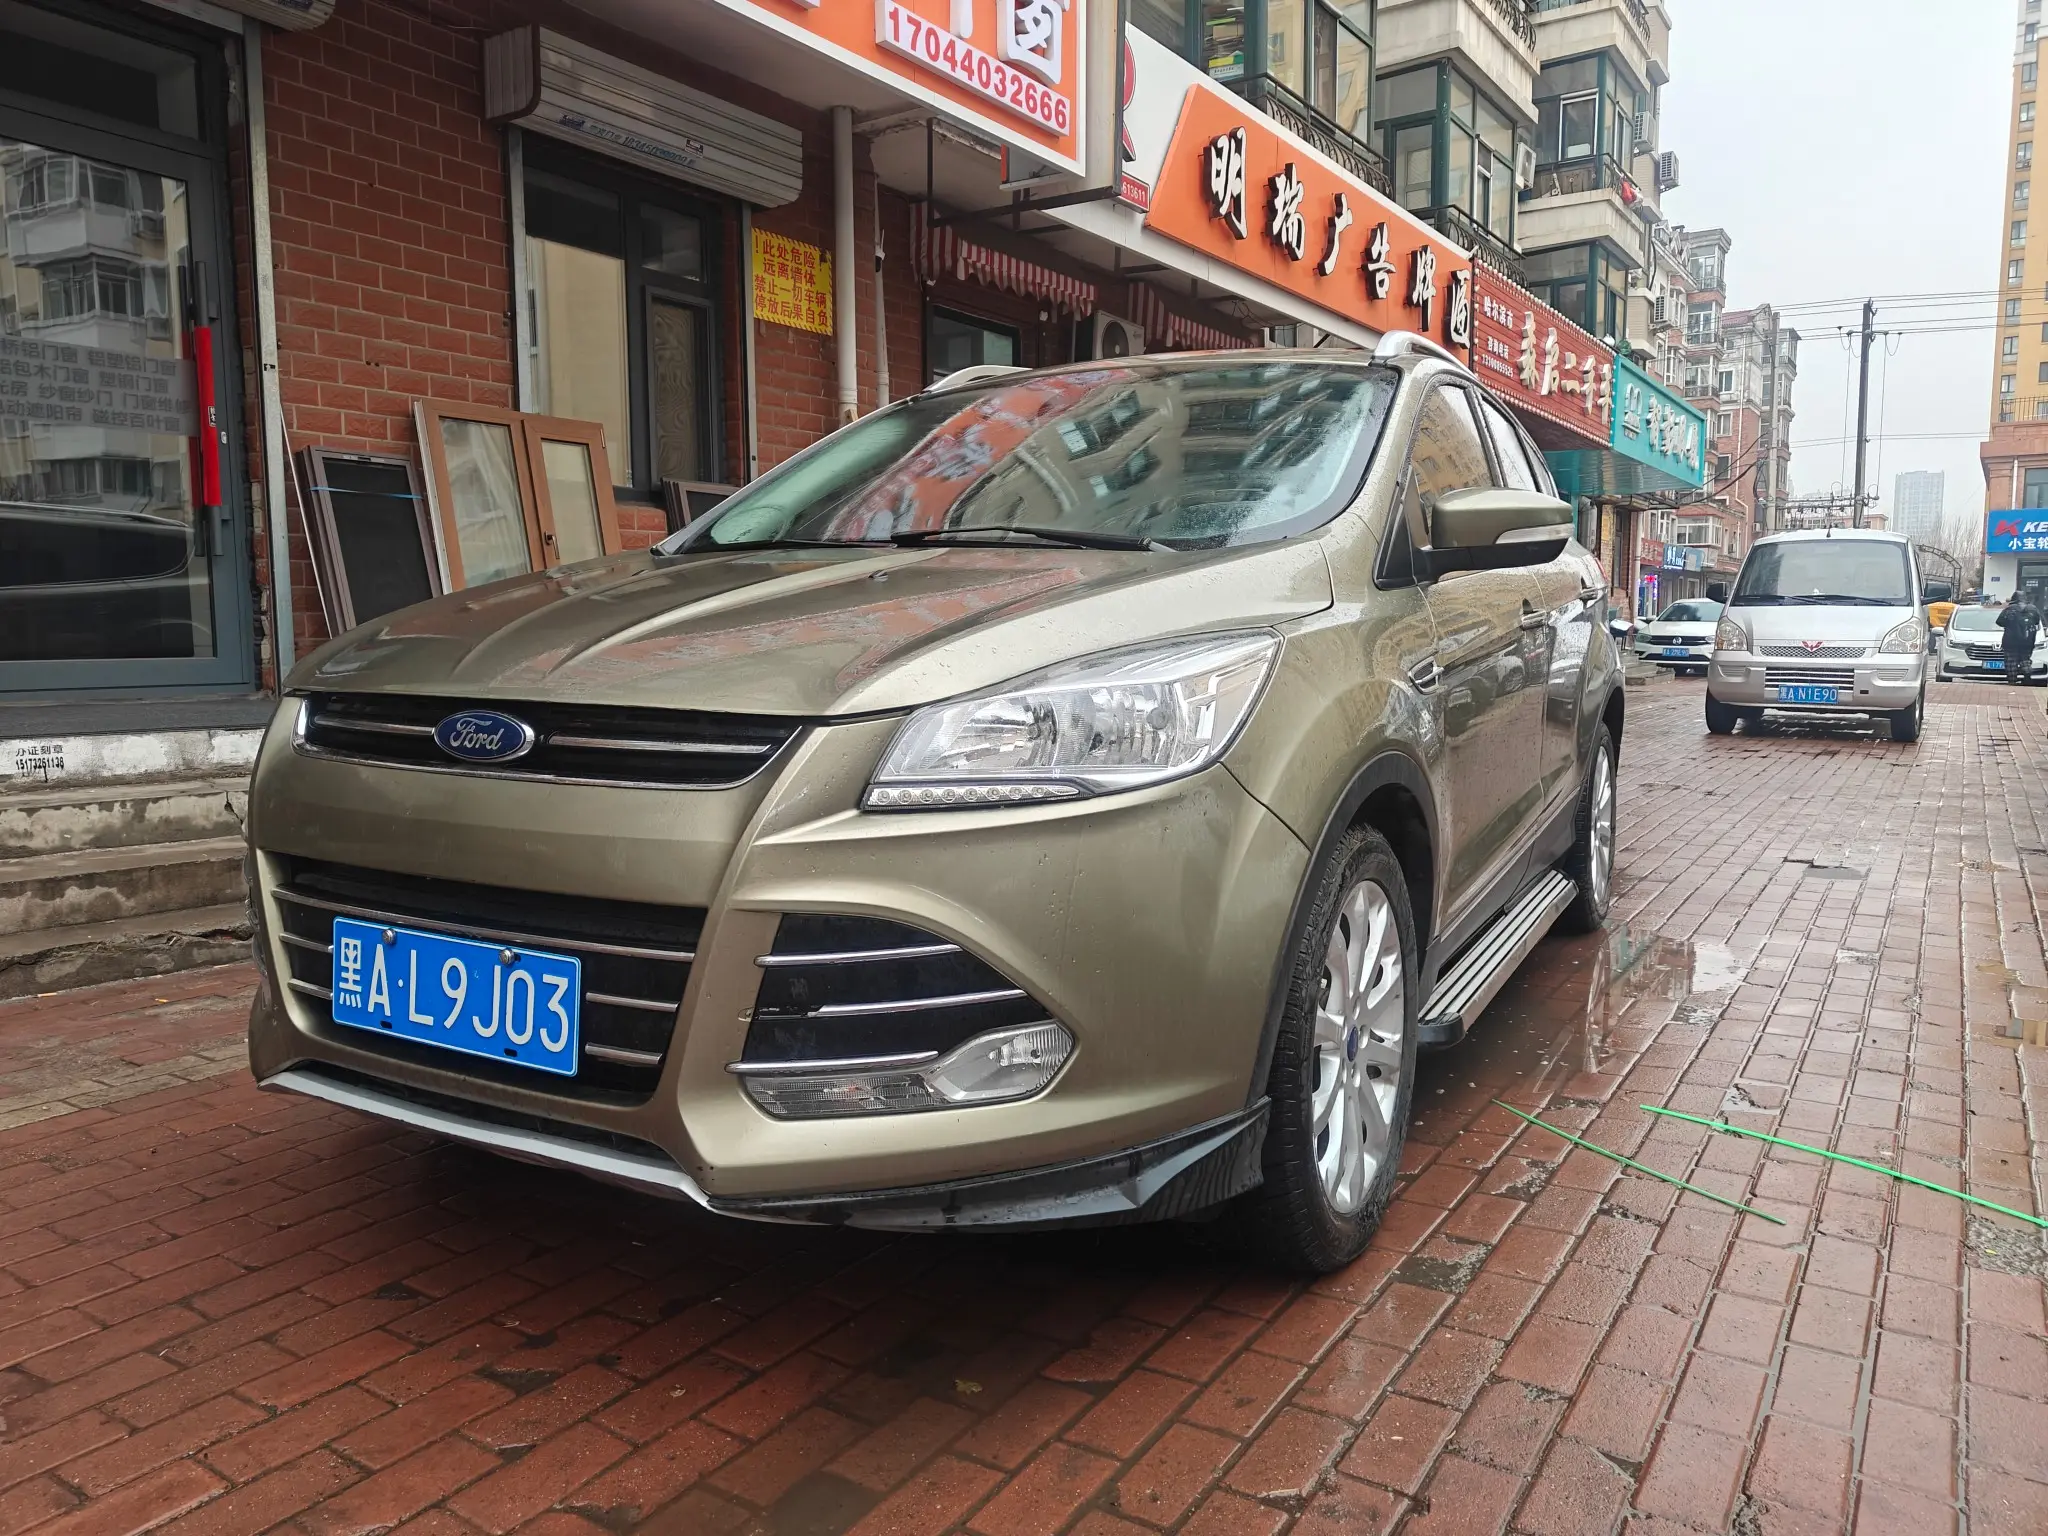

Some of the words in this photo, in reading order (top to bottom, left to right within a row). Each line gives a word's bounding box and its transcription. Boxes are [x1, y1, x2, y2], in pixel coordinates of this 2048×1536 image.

[888, 7, 1068, 130] 17044032666
[1204, 126, 1472, 349] 明瑞广告牌匾
[763, 257, 816, 287] 远离墙体
[754, 274, 827, 309] 禁止一切车辆
[754, 294, 828, 327] 停放后果自负
[1484, 296, 1514, 329] 哈尔滨市
[0, 400, 82, 421] 动遮阳帘
[449, 717, 505, 750] Ford
[15, 744, 64, 757] 办证刻章
